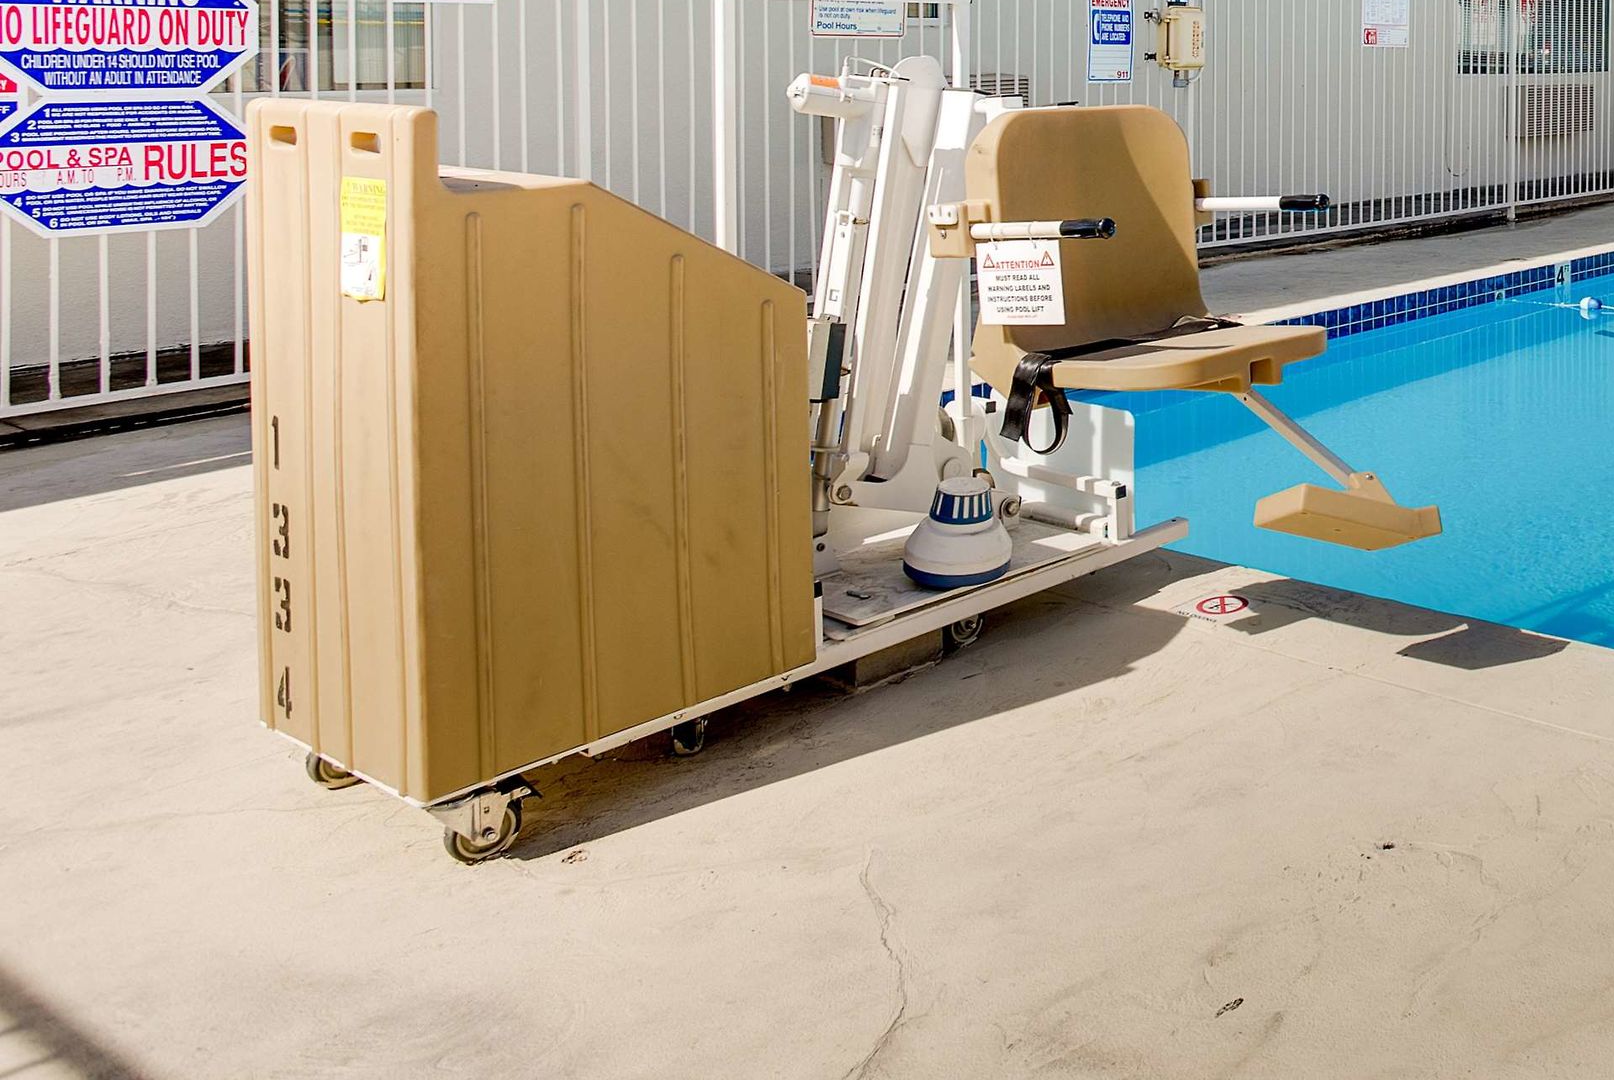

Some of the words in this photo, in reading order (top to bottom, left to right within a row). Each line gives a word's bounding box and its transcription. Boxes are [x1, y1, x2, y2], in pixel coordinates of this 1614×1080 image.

[32, 6, 150, 45] LIFEGUARD
[159, 9, 189, 46] ON
[198, 10, 249, 46] DUTY
[817, 21, 834, 30] Pool
[835, 22, 858, 30] Hours
[21, 54, 71, 69] CHILDREN
[74, 54, 105, 69] UNDER
[107, 54, 117, 68] 14
[118, 54, 155, 69] SHOULD
[157, 54, 177, 69] NOT
[178, 54, 195, 69] USE
[197, 54, 221, 69] POOL
[44, 71, 87, 85] WITHOUT
[89, 71, 102, 85] AN
[104, 71, 132, 85] ADULT
[134, 71, 144, 85] IN
[146, 71, 201, 85] ATTENDANCE
[1116, 71, 1128, 79] 911
[43, 108, 51, 118] 1
[27, 120, 36, 130] 2
[10, 132, 20, 142] 3
[67, 149, 80, 167] &
[89, 146, 132, 166] SPA
[144, 142, 247, 180] RULES
[81, 170, 93, 184] TO
[13, 197, 22, 207] 4
[32, 208, 41, 218] 5
[49, 218, 58, 228] 6
[995, 260, 1040, 270] ATTENTION
[1557, 265, 1565, 285] 4
